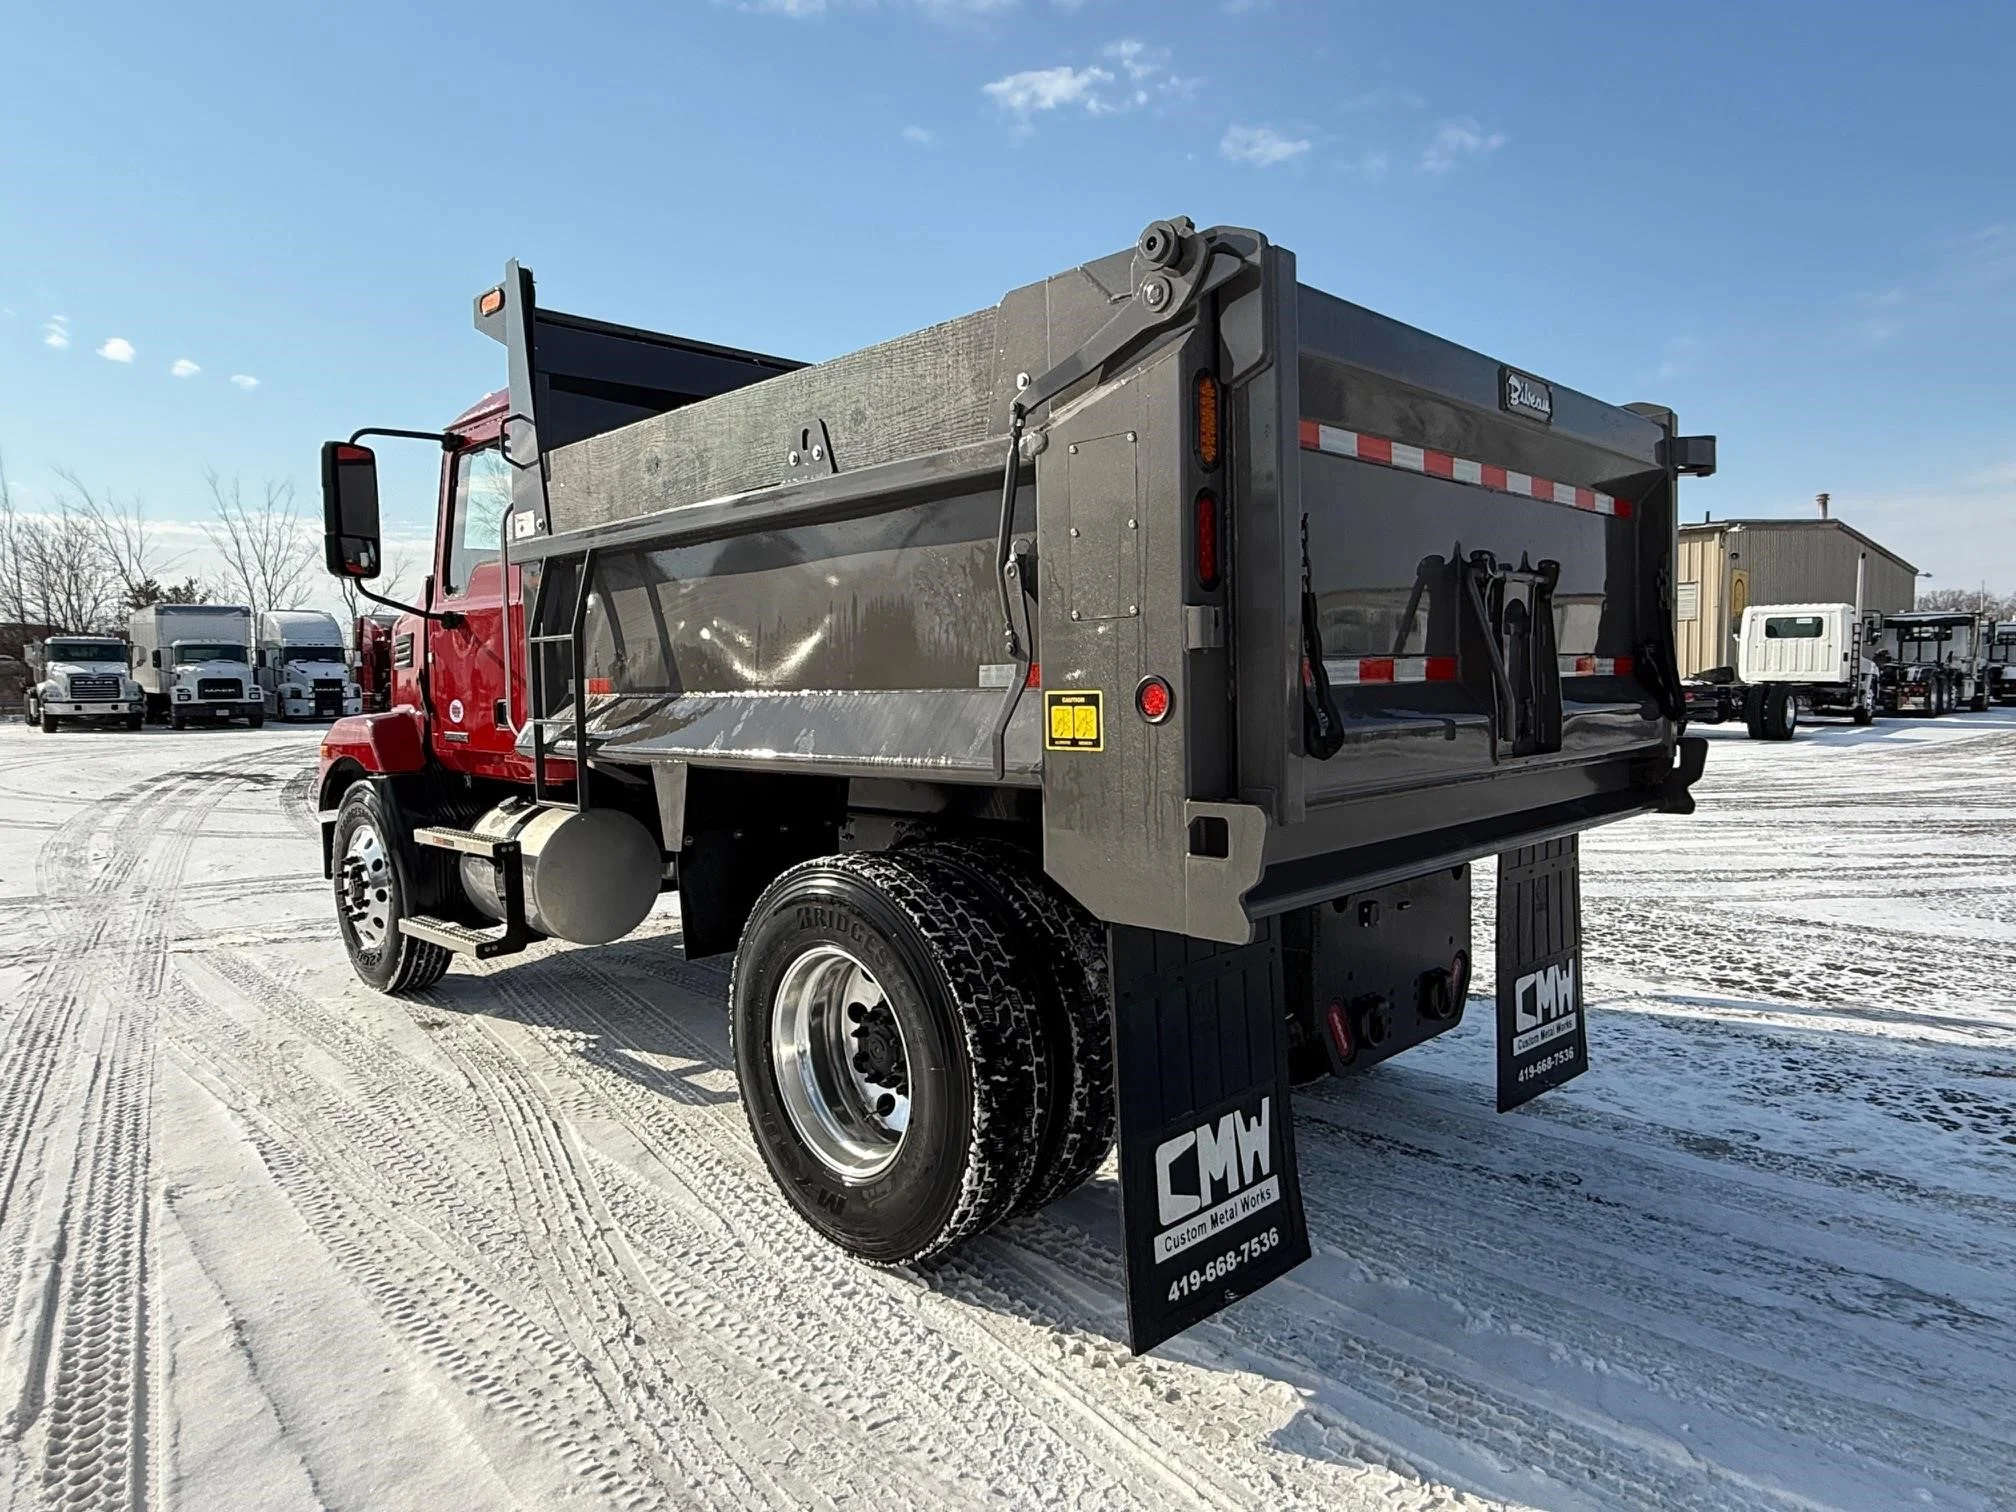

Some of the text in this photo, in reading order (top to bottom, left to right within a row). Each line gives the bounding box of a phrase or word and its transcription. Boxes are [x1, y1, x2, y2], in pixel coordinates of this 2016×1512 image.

[1509, 375, 1551, 414] Bibeau
[1515, 958, 1574, 1033] CMW
[1517, 1019, 1573, 1050] Custom Metal Works
[1518, 1046, 1574, 1083] 419-668-7536
[1155, 1096, 1270, 1227] CMW
[1164, 1186, 1271, 1253] Custom Metal Works
[1168, 1226, 1280, 1302] 419-668-7536
